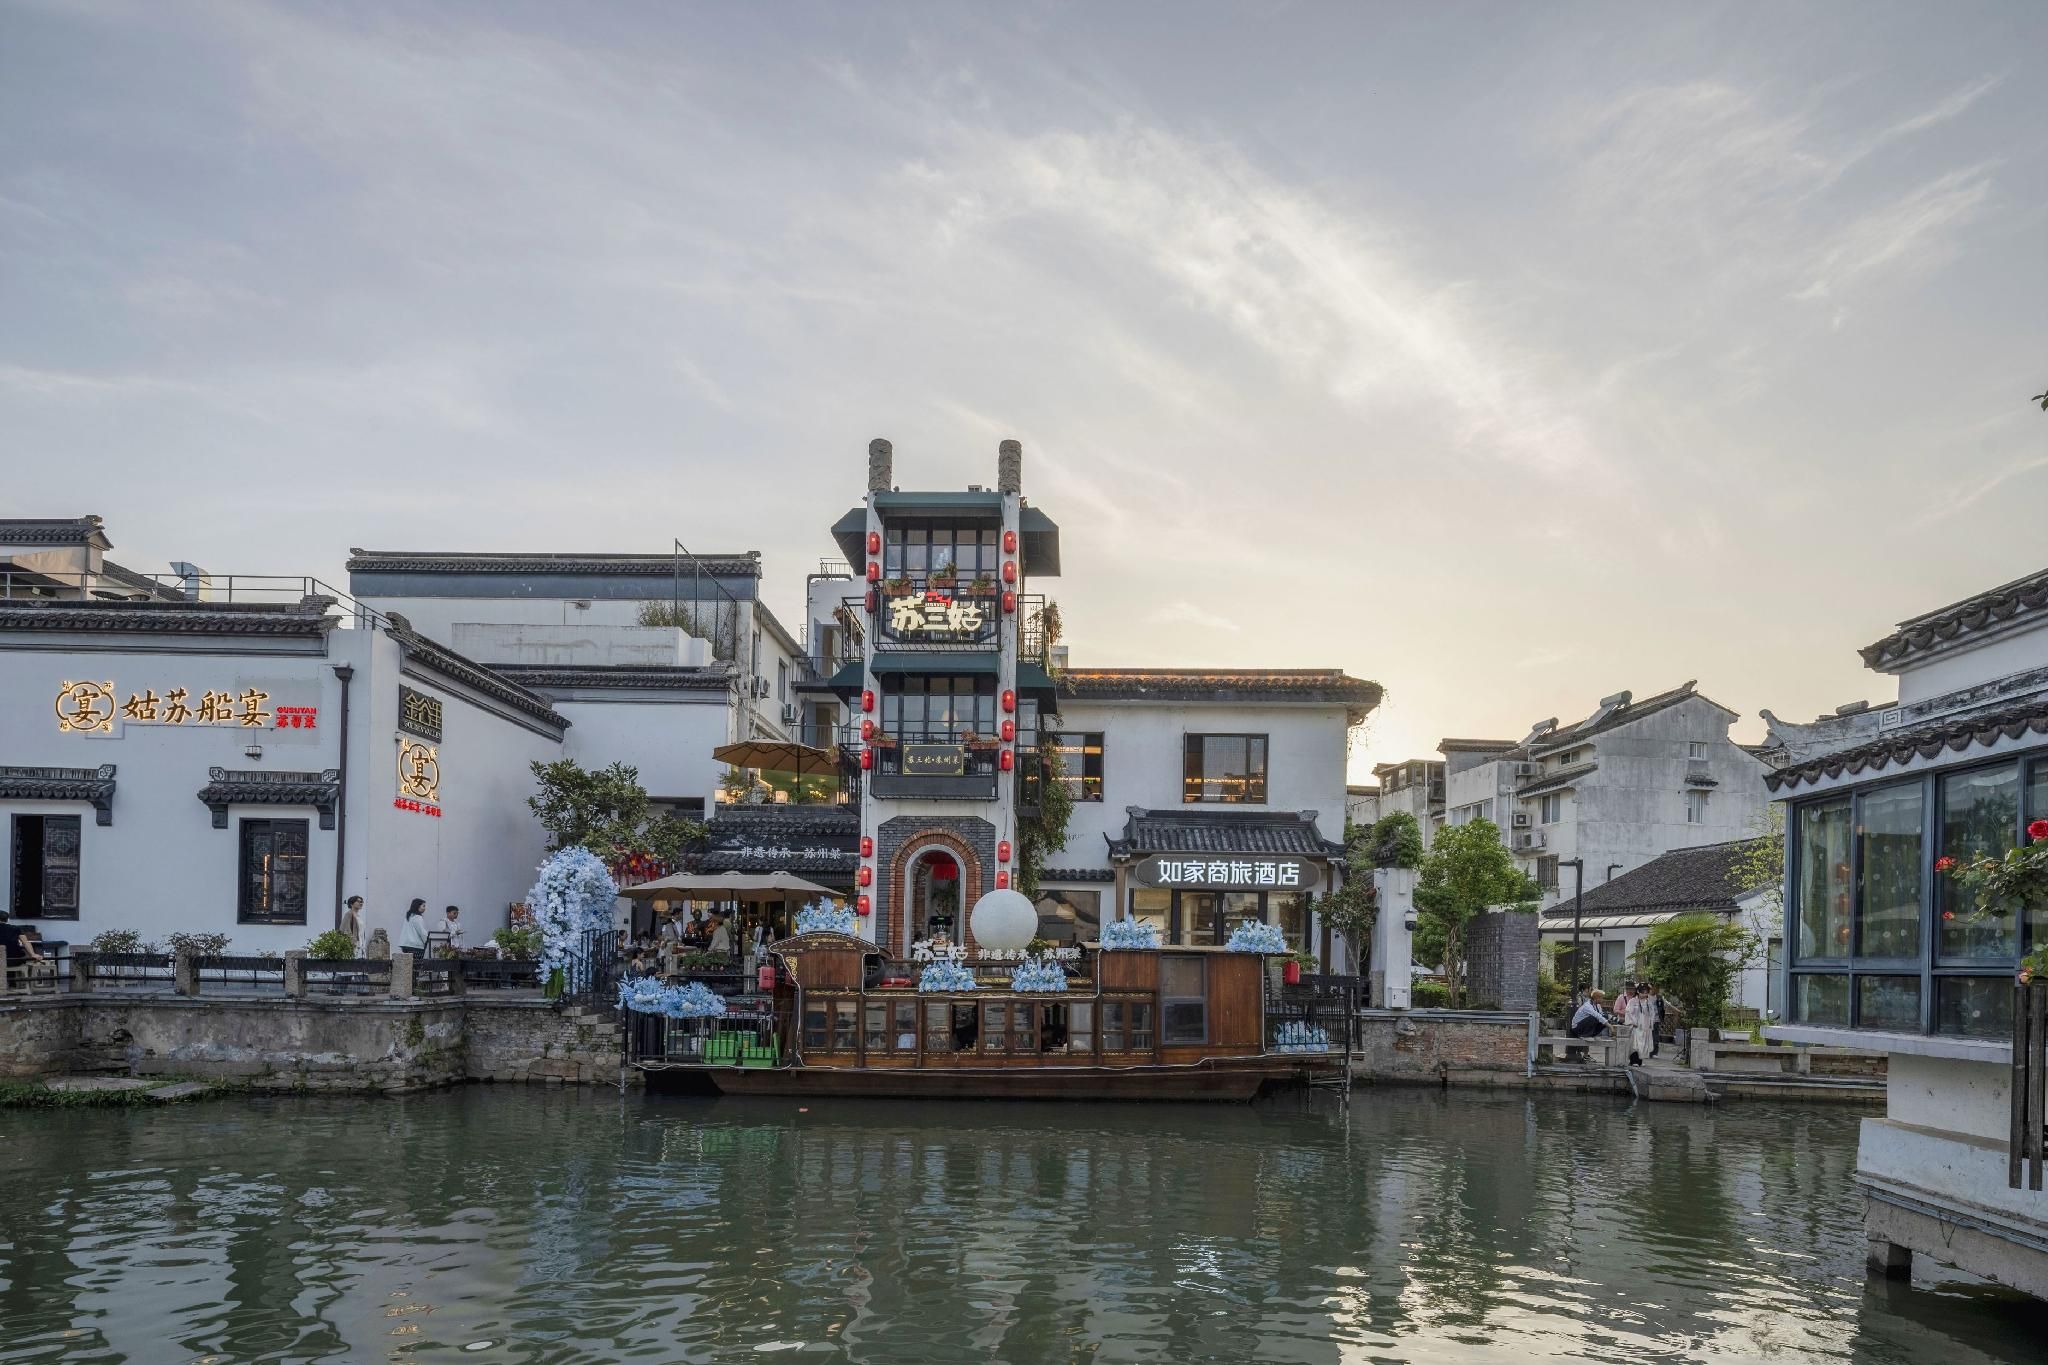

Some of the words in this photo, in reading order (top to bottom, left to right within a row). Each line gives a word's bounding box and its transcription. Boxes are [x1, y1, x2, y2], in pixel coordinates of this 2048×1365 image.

[888, 592, 983, 631] 苏三姑
[67, 687, 102, 724] 宴
[120, 687, 271, 727] 姑苏船宴
[277, 706, 317, 715] GUSUYAN
[409, 750, 431, 791] 宴
[1157, 859, 1300, 886] 如家商旅酒店
[911, 938, 969, 962] 苏三姑
